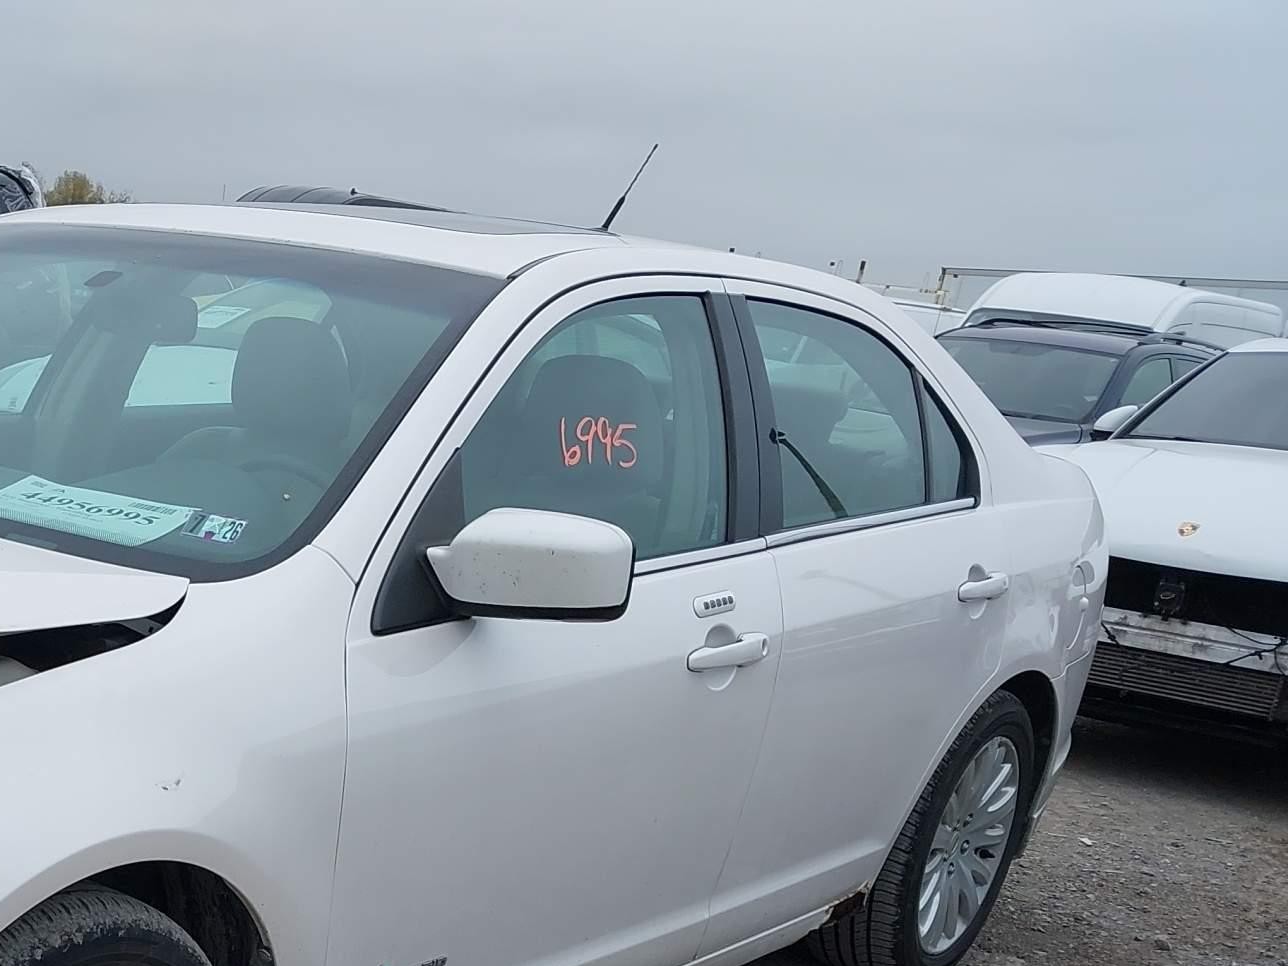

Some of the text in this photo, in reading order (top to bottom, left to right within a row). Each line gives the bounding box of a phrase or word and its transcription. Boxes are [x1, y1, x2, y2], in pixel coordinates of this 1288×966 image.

[559, 415, 638, 470] 6995
[21, 491, 161, 527] 44956995
[222, 520, 244, 541] 26
